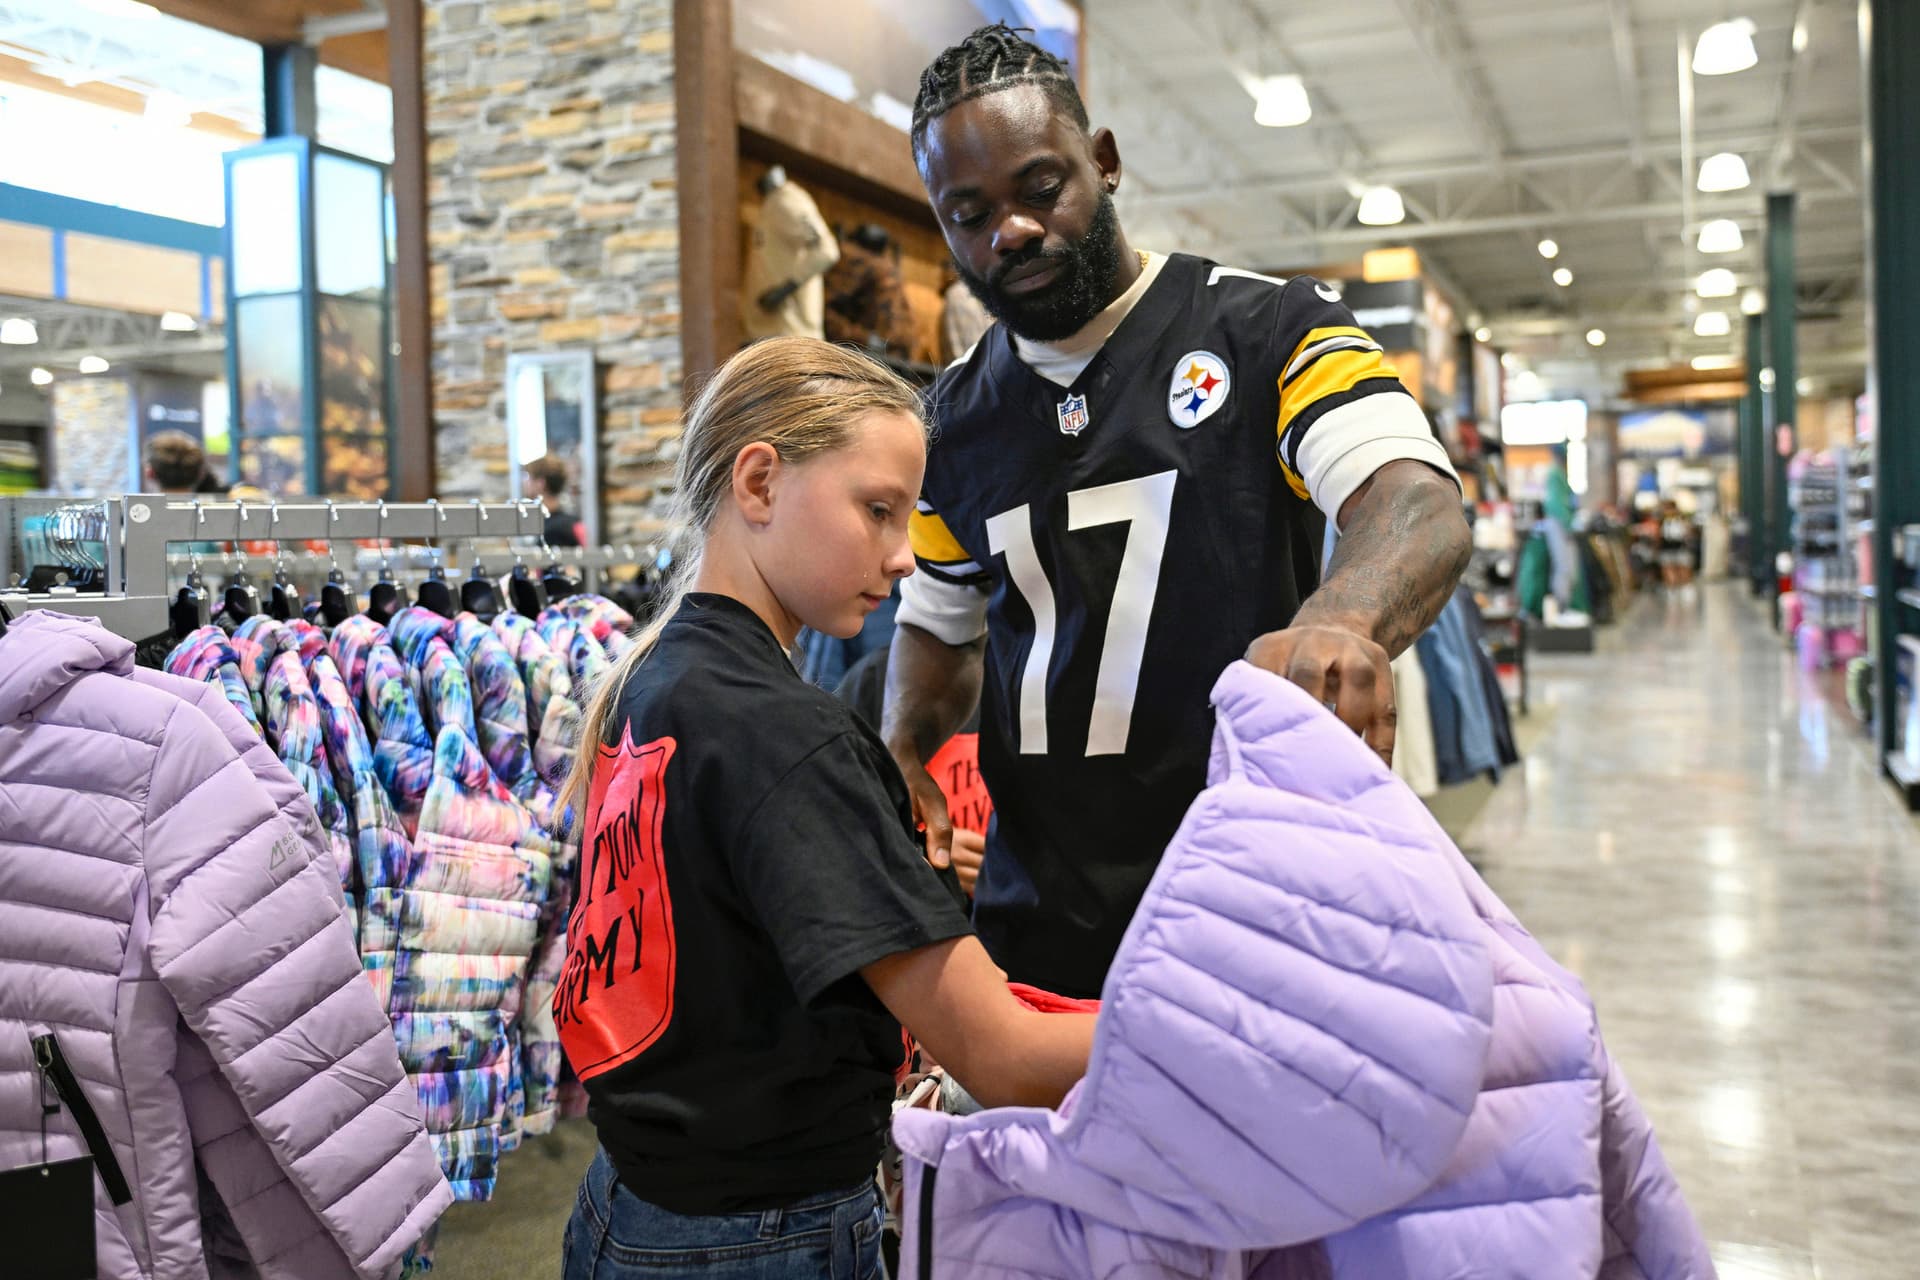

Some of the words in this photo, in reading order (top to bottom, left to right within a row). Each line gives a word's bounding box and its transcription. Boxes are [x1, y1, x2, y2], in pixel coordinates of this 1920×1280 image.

[1063, 410, 1084, 429] NFL
[1172, 386, 1194, 403] Steelers
[985, 469, 1178, 757] 17
[552, 887, 645, 1032] ARMY
